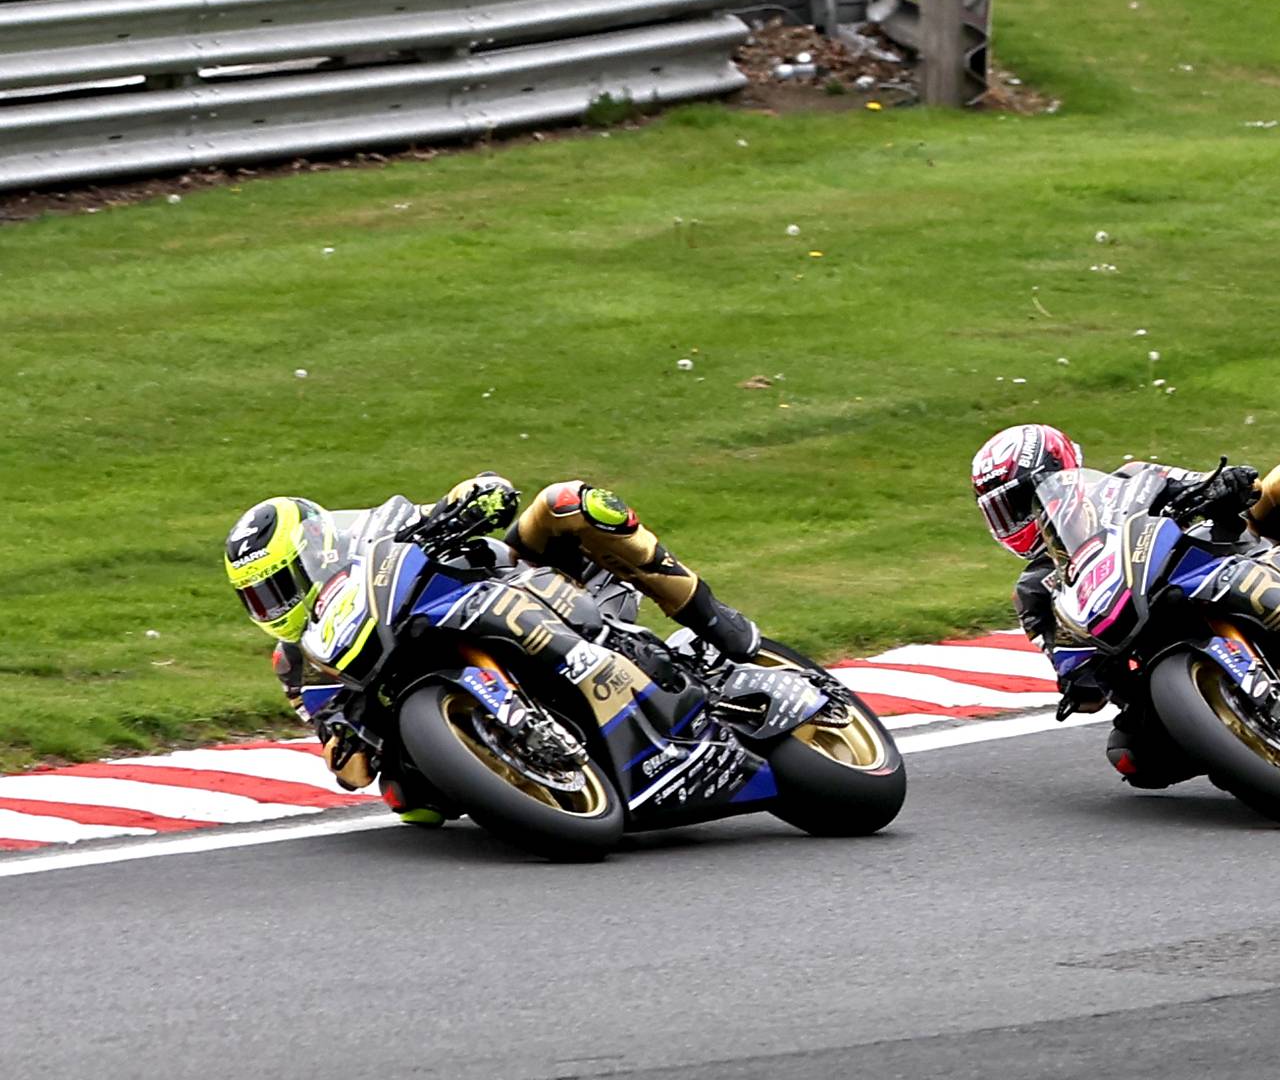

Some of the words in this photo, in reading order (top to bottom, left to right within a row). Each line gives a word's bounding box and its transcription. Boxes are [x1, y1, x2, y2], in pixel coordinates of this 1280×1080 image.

[975, 465, 1009, 487] SHARK
[231, 547, 270, 568] SHARK
[593, 669, 631, 702] OMG
